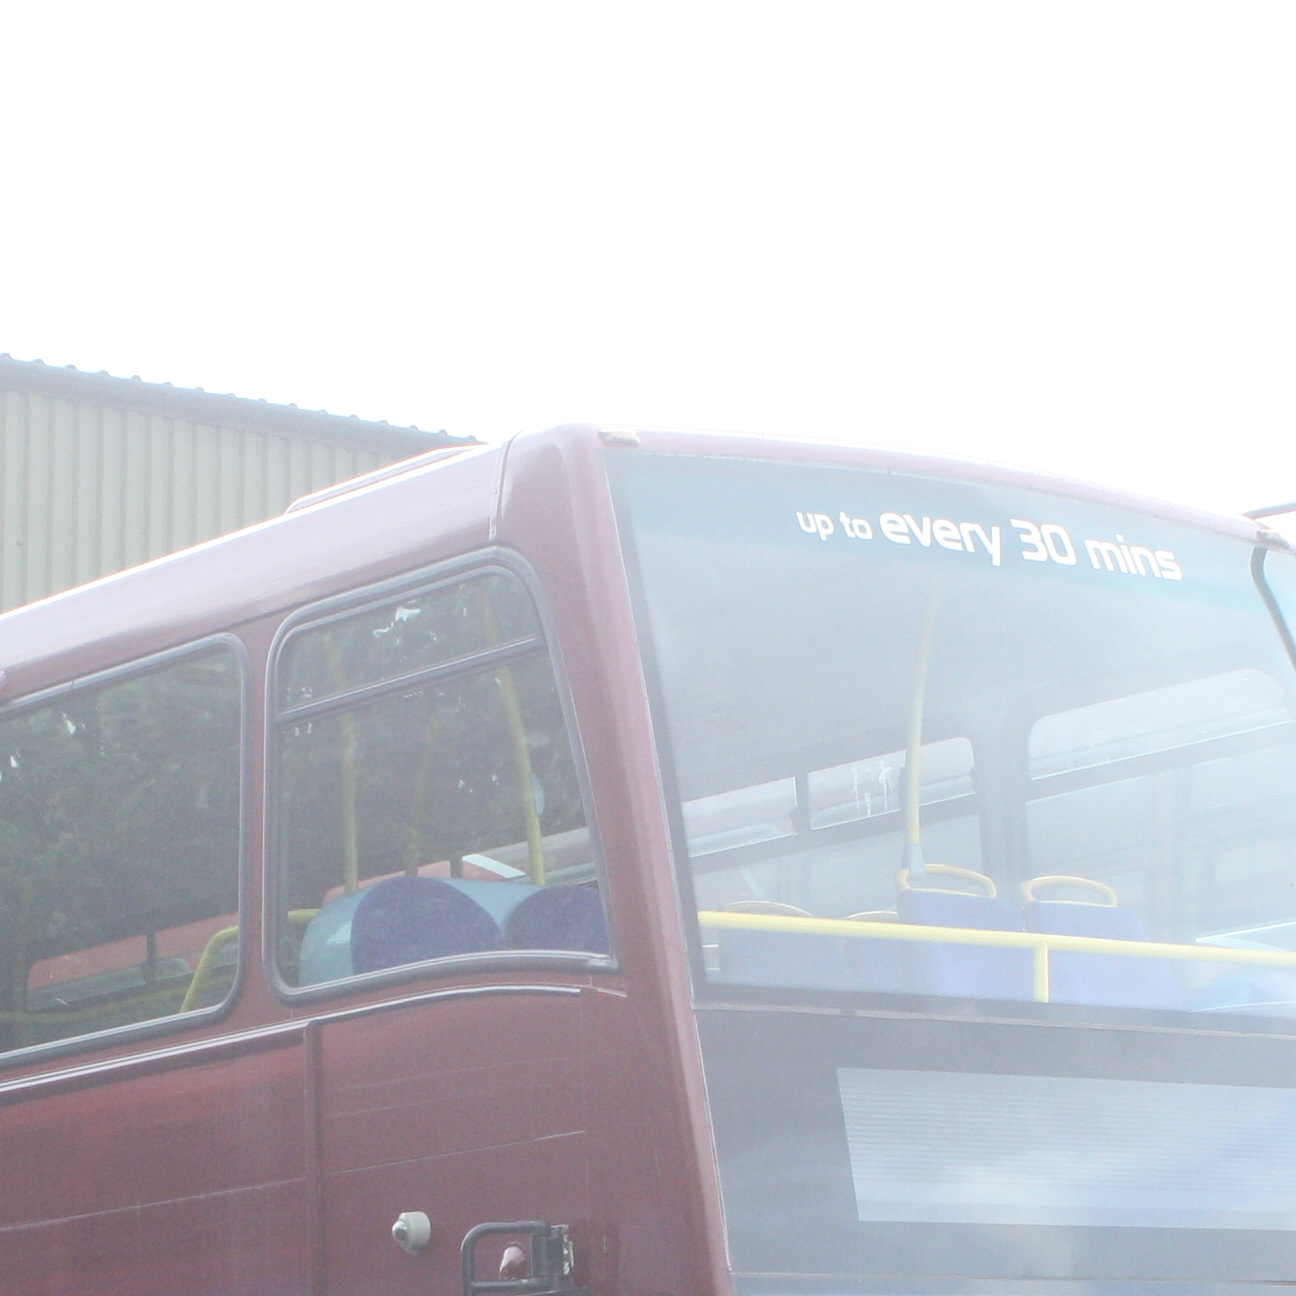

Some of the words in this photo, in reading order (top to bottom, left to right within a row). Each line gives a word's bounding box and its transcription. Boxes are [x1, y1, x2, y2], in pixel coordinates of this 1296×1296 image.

[796, 511, 834, 541] up
[839, 511, 873, 541] to
[880, 510, 1001, 566] every
[1010, 518, 1078, 566] 30
[1084, 533, 1184, 580] mins
